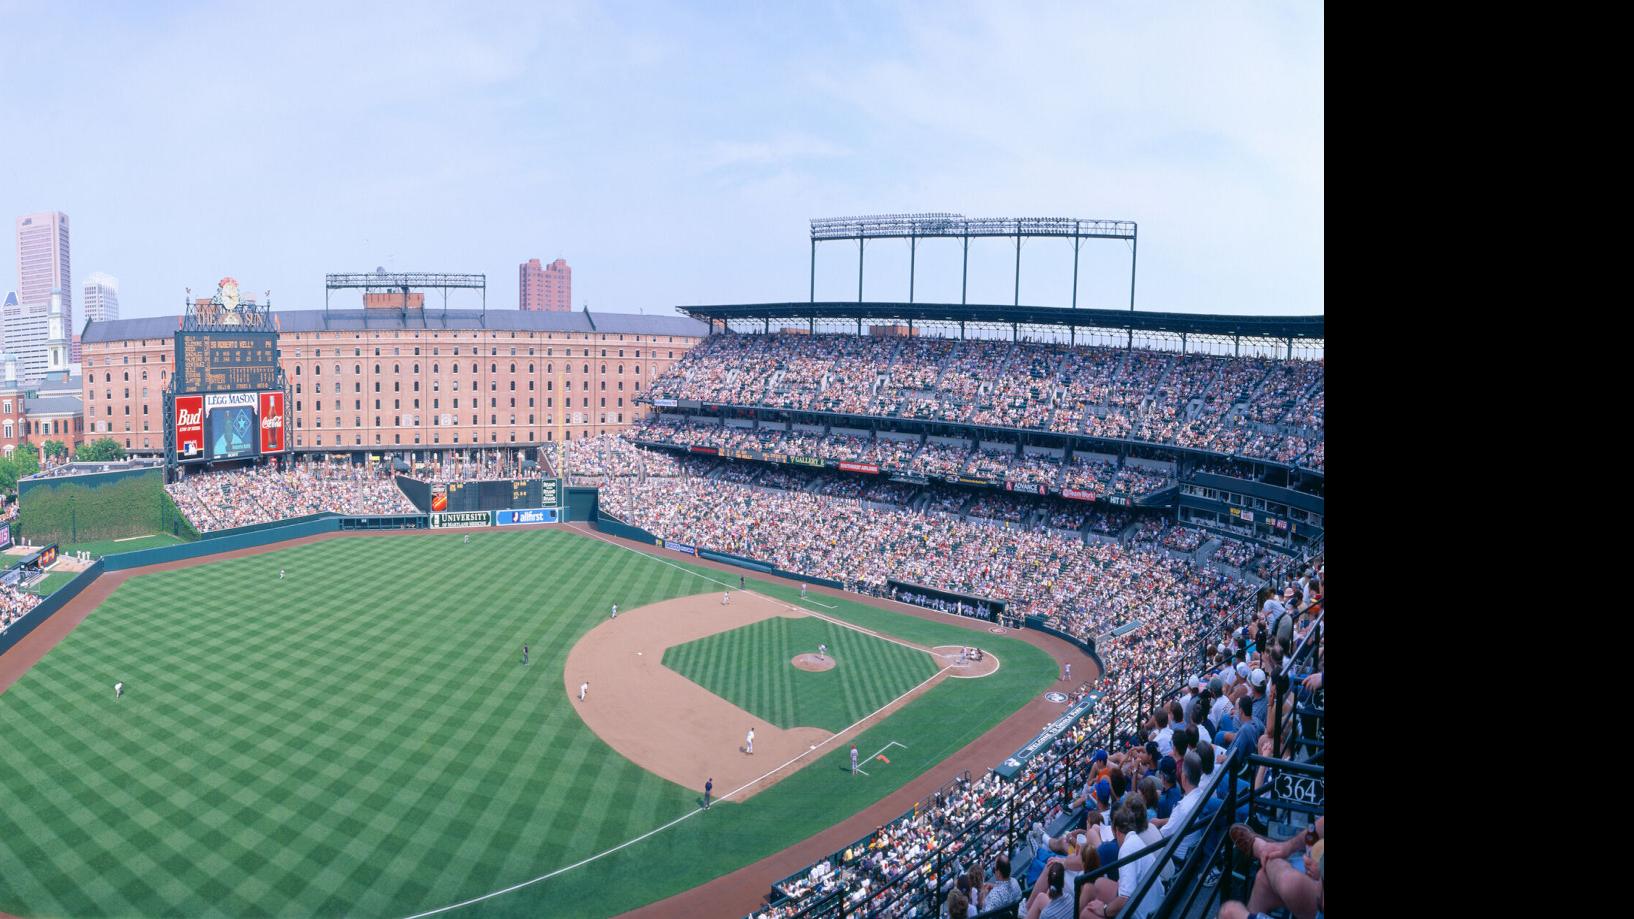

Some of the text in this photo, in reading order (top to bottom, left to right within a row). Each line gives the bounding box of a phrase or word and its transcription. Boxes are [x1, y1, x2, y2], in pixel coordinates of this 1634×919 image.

[197, 312, 264, 326] THE SUN
[229, 394, 255, 404] MASON
[177, 408, 202, 426] Bud
[442, 513, 487, 522] UNIVERSITY
[520, 511, 543, 522] allfirst
[1283, 776, 1316, 802] 364
